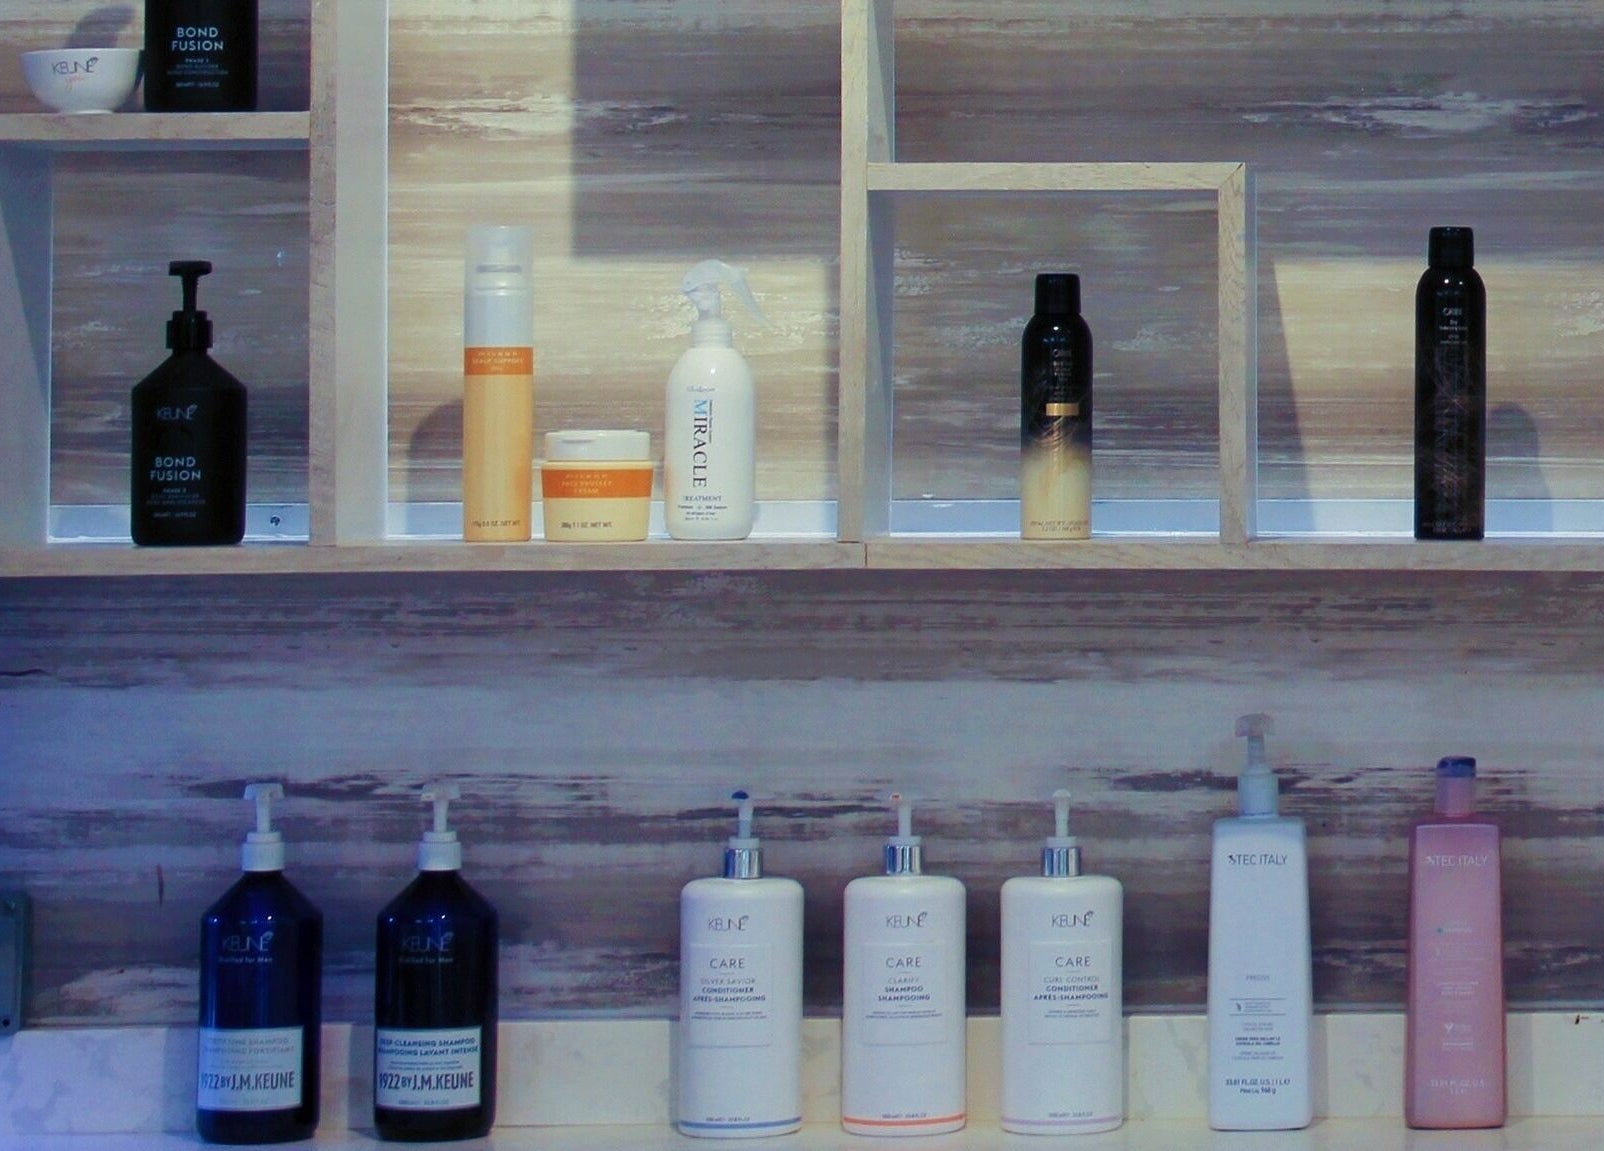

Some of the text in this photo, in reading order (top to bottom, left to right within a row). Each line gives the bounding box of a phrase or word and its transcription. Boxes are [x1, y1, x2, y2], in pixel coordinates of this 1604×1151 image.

[177, 27, 218, 38] BOND
[171, 40, 224, 51] FUSION
[52, 58, 97, 75] KEUNE
[692, 399, 708, 488] MIRACLE
[155, 457, 196, 467] BOND
[150, 470, 201, 481] FUSION
[1259, 854, 1287, 865] ITALY
[1459, 856, 1487, 866] ITALY
[886, 914, 926, 928] KEUNE
[1052, 913, 1091, 928] KEUNE
[709, 958, 746, 969] CARE
[886, 957, 922, 968] CARE
[1055, 956, 1091, 967] CARE
[394, 1038, 437, 1047] CLEANSING
[438, 1037, 475, 1047] SHAMPOO
[420, 1047, 449, 1056] LAVANT
[201, 1071, 295, 1090] 1922 BY J.M.KEUNE
[379, 1071, 474, 1091] 1922 BY J.M.KEUNE
